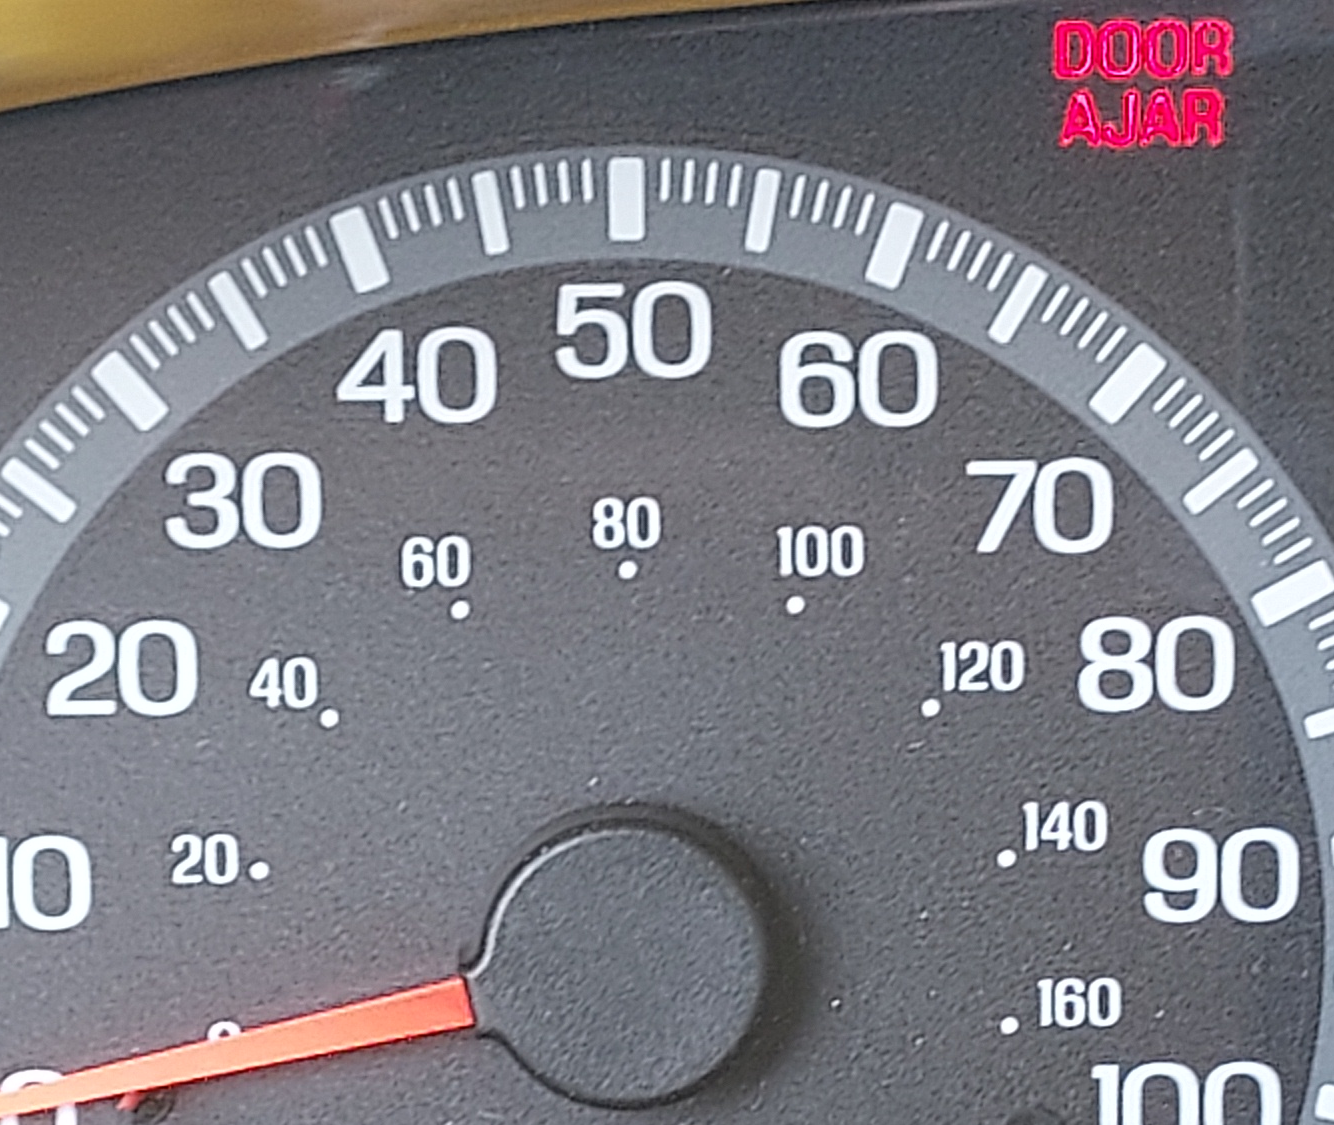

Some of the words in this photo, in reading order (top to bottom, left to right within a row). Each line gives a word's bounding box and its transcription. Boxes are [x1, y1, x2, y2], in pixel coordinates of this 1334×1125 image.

[1053, 18, 1233, 80] DOOR
[1060, 88, 1226, 148] AJAR
[555, 280, 712, 379] 50
[336, 326, 497, 424] 40
[779, 330, 938, 428] 60
[165, 452, 322, 549] 30
[592, 496, 661, 549] 80
[965, 456, 1114, 554] 70
[401, 535, 471, 588] 60
[776, 525, 865, 577] 100
[46, 619, 198, 717] 20
[249, 656, 318, 709] 40
[940, 640, 1025, 692] 120
[1077, 614, 1235, 713] 80
[1022, 800, 1108, 852] 140
[171, 833, 240, 885] 20
[1142, 827, 1300, 924] 90
[1037, 977, 1122, 1028] 160
